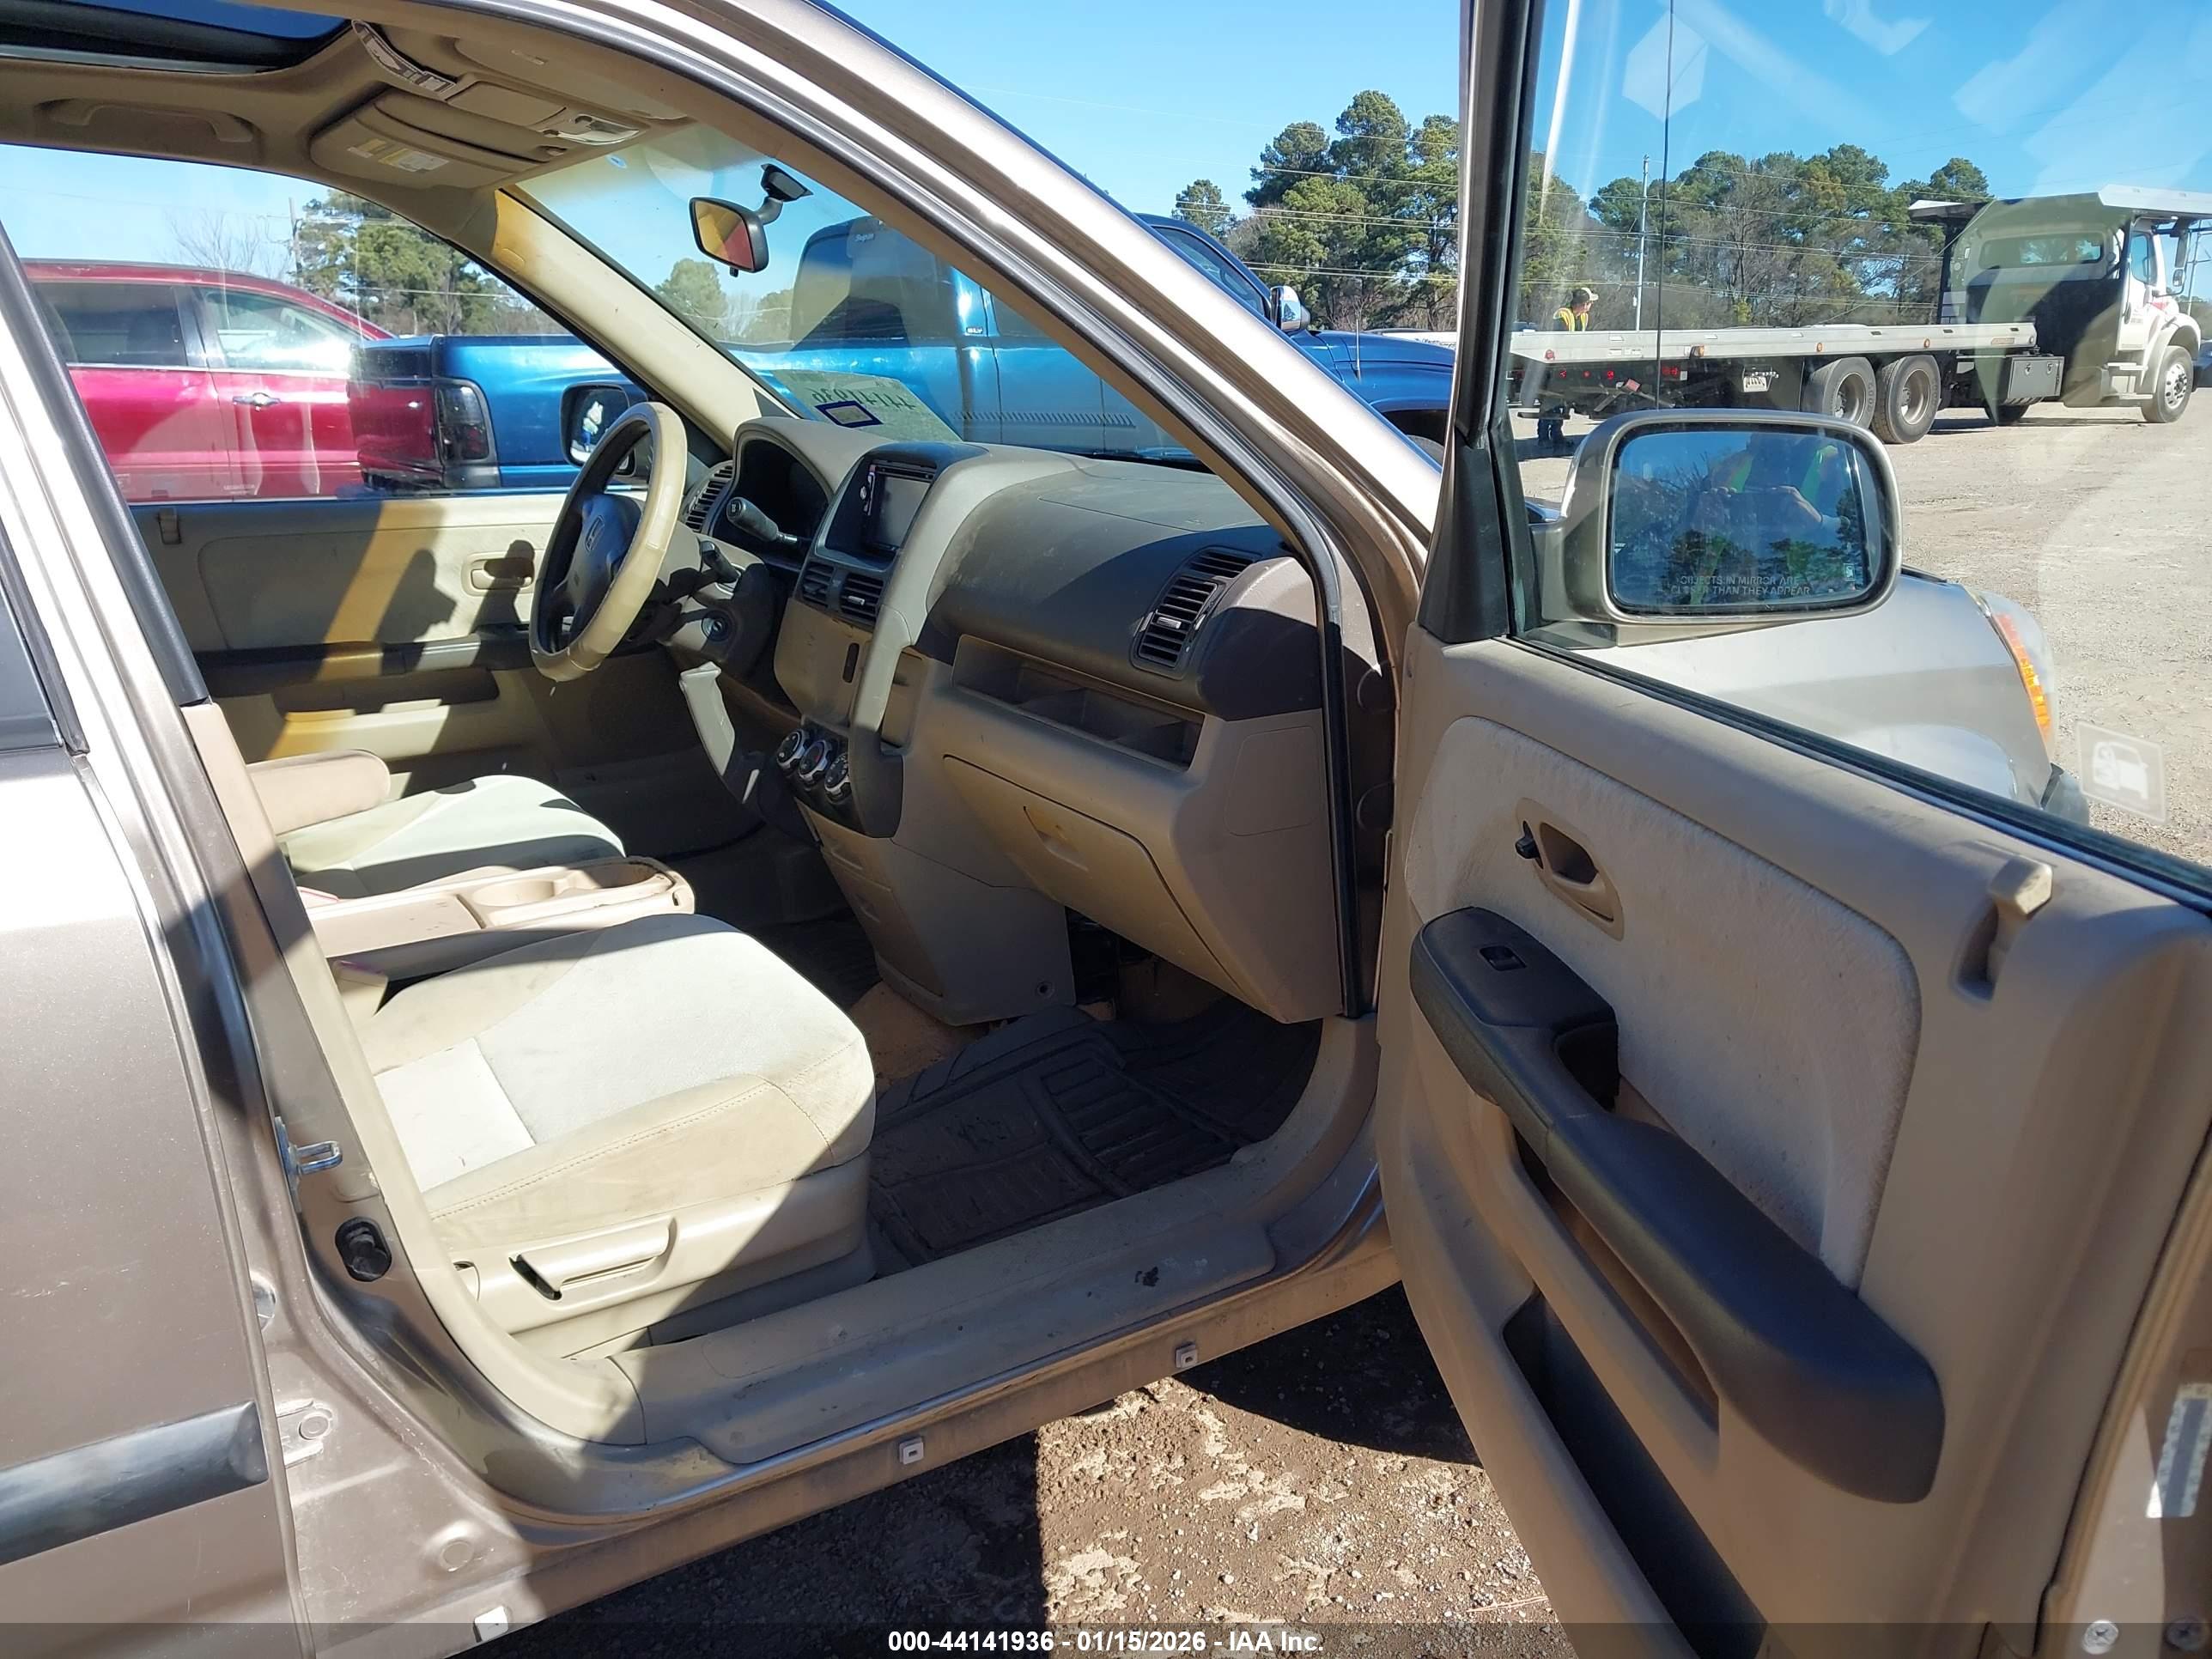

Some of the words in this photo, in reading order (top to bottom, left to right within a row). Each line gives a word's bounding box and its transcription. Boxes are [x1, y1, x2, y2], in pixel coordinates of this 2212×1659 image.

[1680, 575, 1723, 585] OBJECTS
[1725, 576, 1735, 585] IN
[1738, 576, 1776, 585] MIRROR
[1779, 576, 1800, 585] ARE
[1711, 586, 1740, 594] THAN
[1741, 586, 1768, 595] THEY
[1770, 586, 1810, 595] APPEAR
